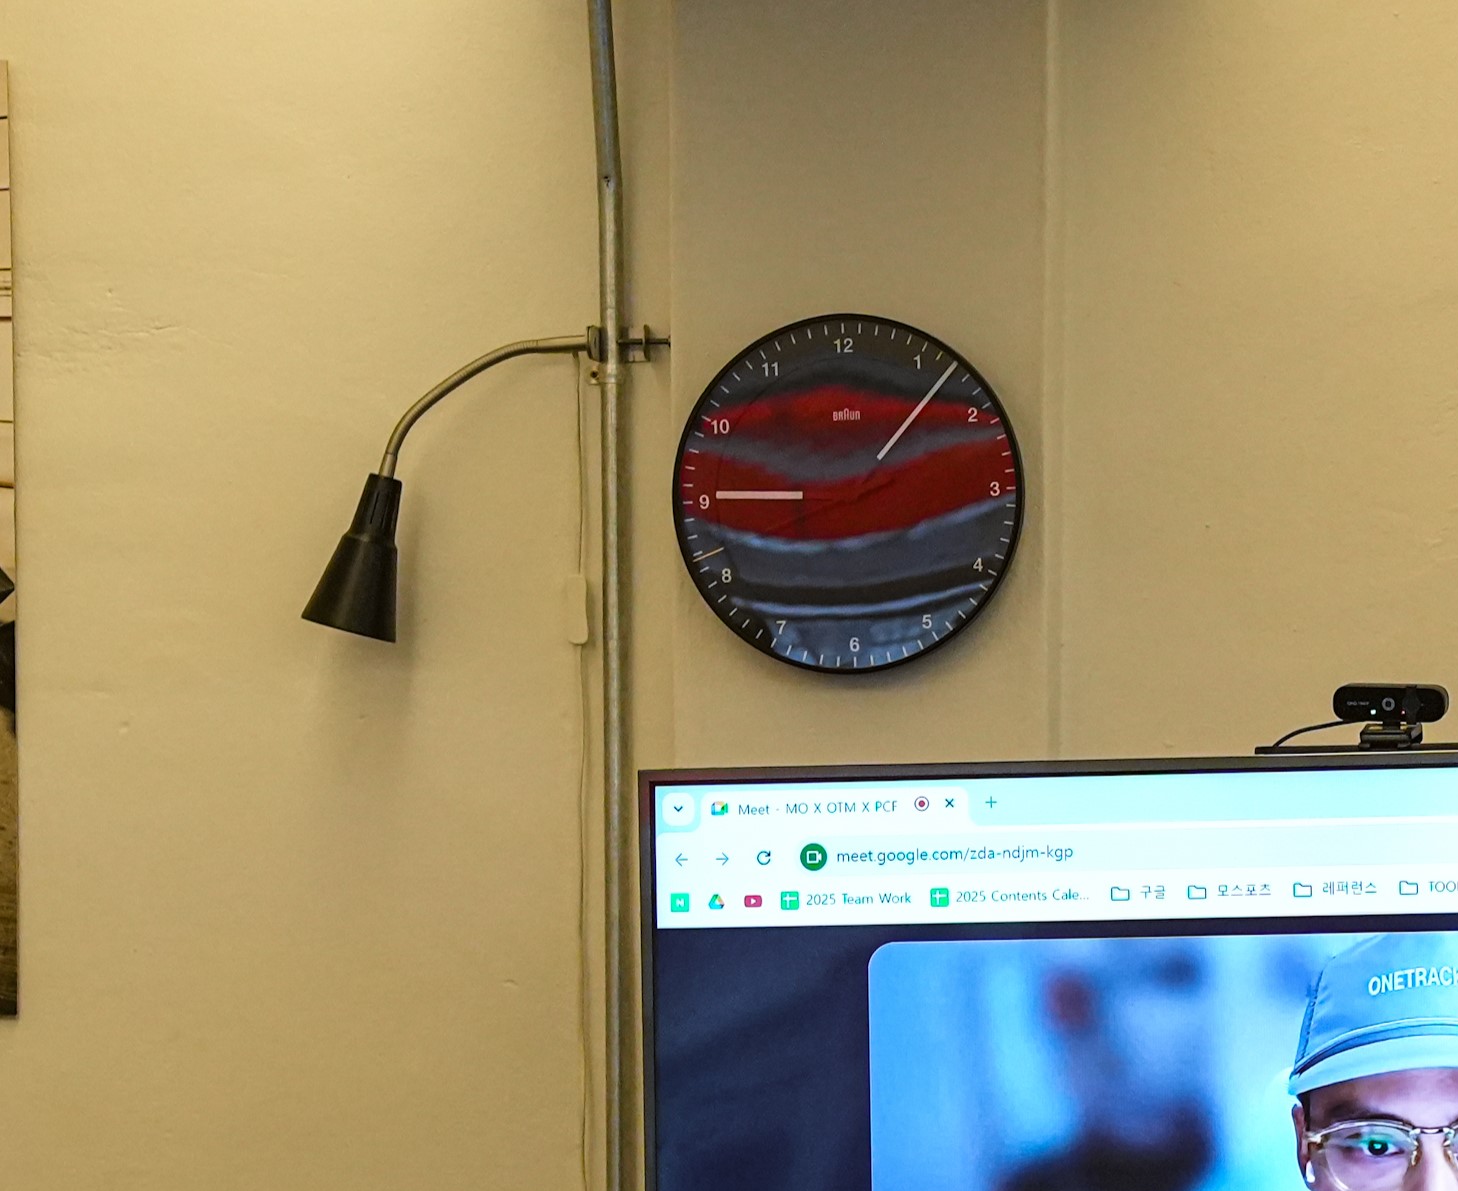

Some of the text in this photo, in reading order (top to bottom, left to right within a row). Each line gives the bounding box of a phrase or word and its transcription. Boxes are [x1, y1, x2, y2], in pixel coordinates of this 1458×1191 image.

[833, 338, 854, 353] 12
[761, 362, 780, 376] 11
[913, 355, 922, 369] 1
[832, 407, 861, 421] BRAUN
[968, 409, 978, 422] 2
[710, 419, 729, 433] 10
[989, 482, 1000, 496] 3
[699, 495, 710, 509] 9
[972, 558, 983, 571] 4
[721, 569, 731, 583] 8
[776, 621, 786, 635] 7
[922, 616, 933, 630] 5
[849, 638, 860, 653] 6
[738, 800, 898, 816] Meet MO X OTM X PCF
[836, 845, 1074, 866] meet.google.com/zda-ndjm-kgp
[1140, 885, 1166, 900] 구글
[1217, 884, 1272, 897] 모스포츠
[1322, 881, 1377, 896] 레퍼런스
[806, 892, 912, 906] 2025 Team Work
[956, 891, 986, 903] 2025
[991, 890, 1048, 902] Contents
